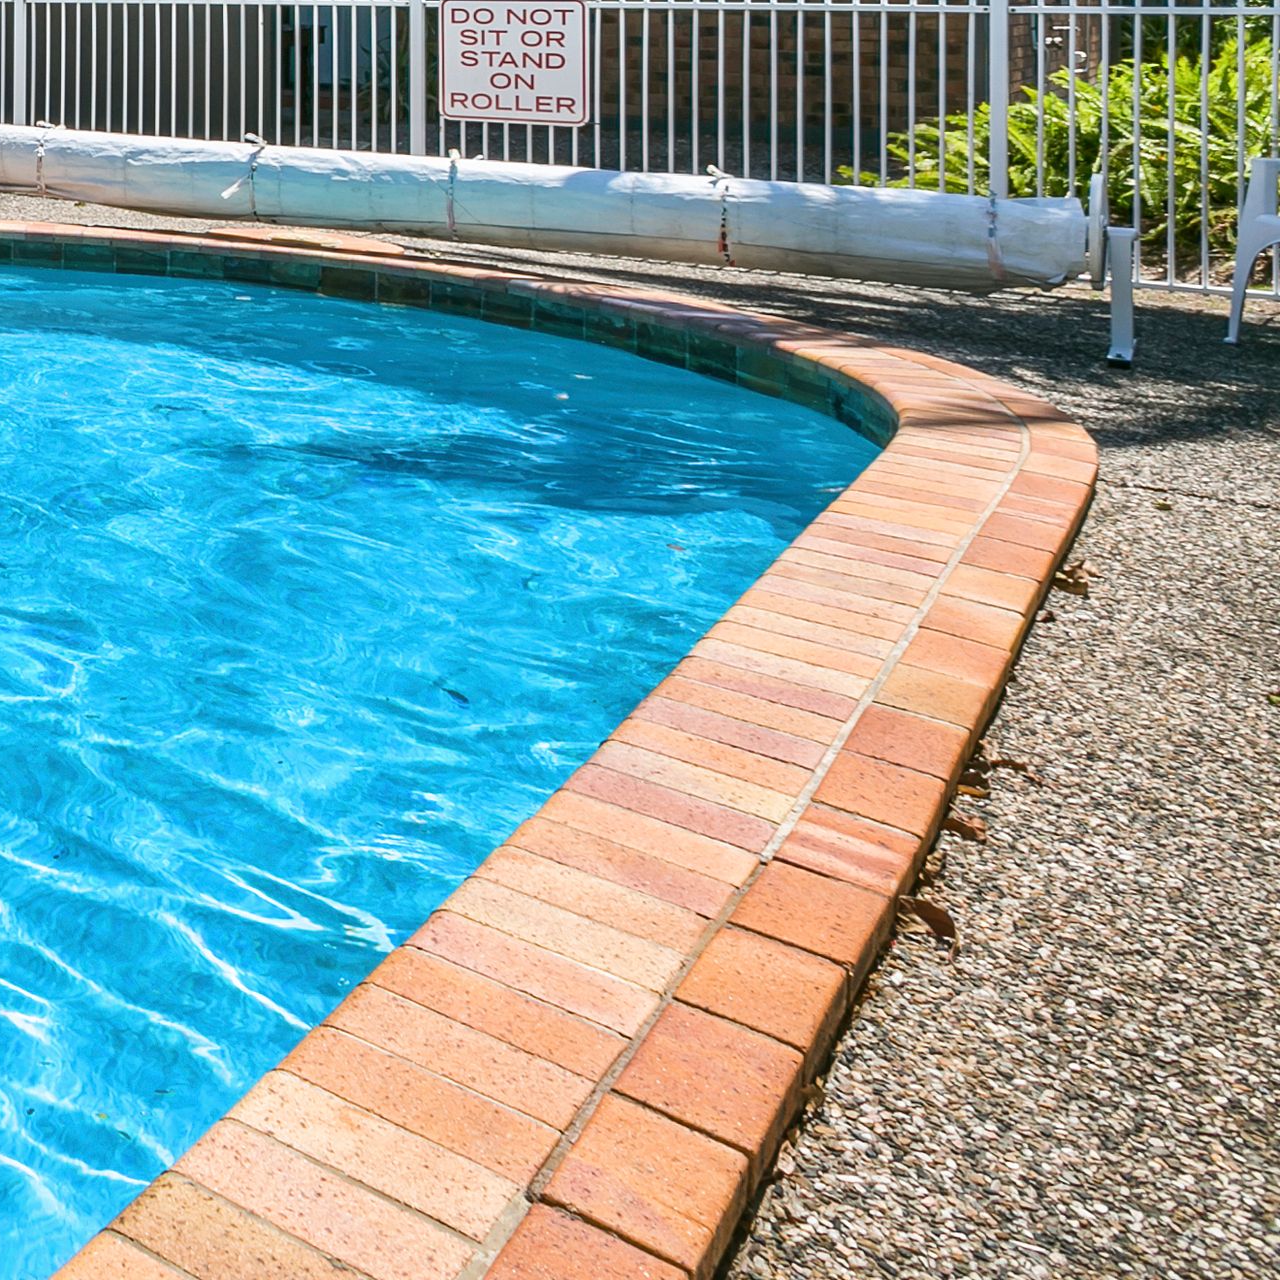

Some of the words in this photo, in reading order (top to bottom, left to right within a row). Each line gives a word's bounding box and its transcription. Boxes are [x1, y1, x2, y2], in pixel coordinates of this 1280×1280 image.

[450, 8, 494, 24] DO
[506, 9, 574, 25] NOT
[459, 29, 508, 46] SIT
[520, 30, 565, 47] OR
[460, 50, 565, 69] STAND
[490, 72, 535, 90] ON
[450, 92, 576, 114] ROLLER
